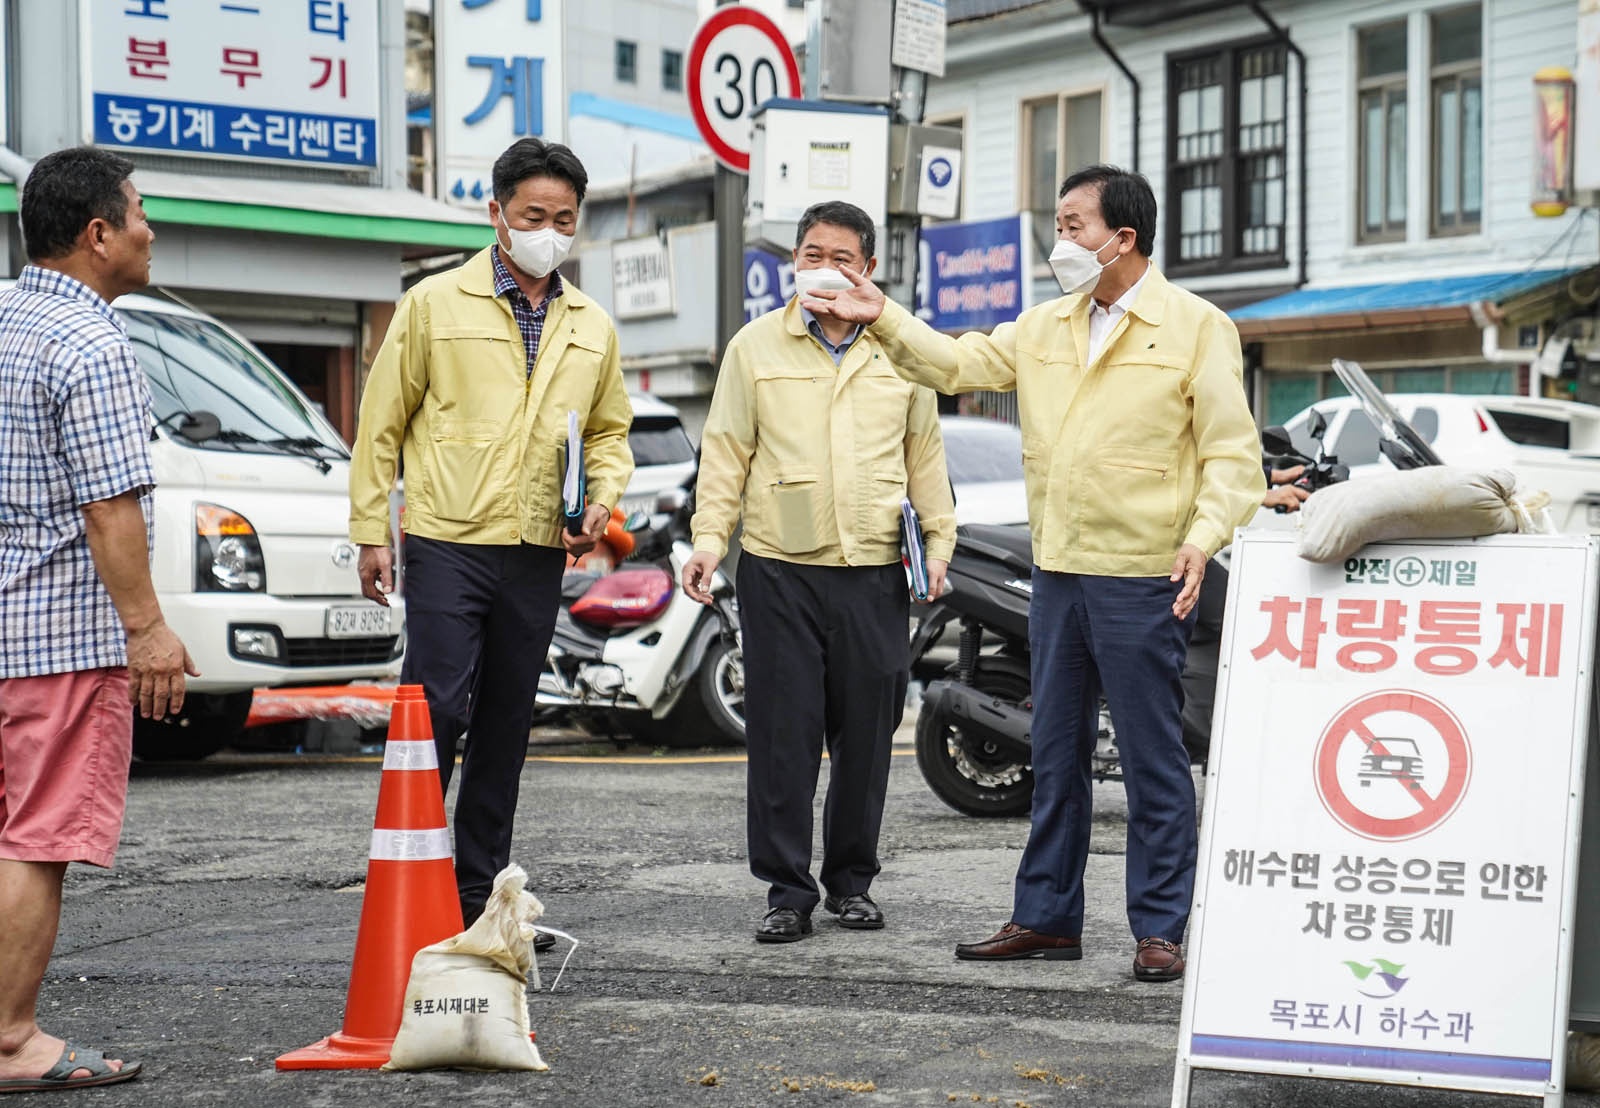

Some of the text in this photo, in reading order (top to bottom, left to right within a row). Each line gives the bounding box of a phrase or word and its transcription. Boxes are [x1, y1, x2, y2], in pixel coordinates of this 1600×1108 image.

[715, 54, 778, 120] 30
[107, 101, 366, 160] 농기계 수리쎈타
[1343, 557, 1477, 586] 안전 제일
[1251, 596, 1564, 677] 차량통제
[1223, 849, 1548, 902] 해수면 상승으로 인한
[1302, 901, 1454, 946] 차량통제
[413, 997, 489, 1017] 목포시재대본
[1269, 999, 1474, 1043] 목포시 하수과
